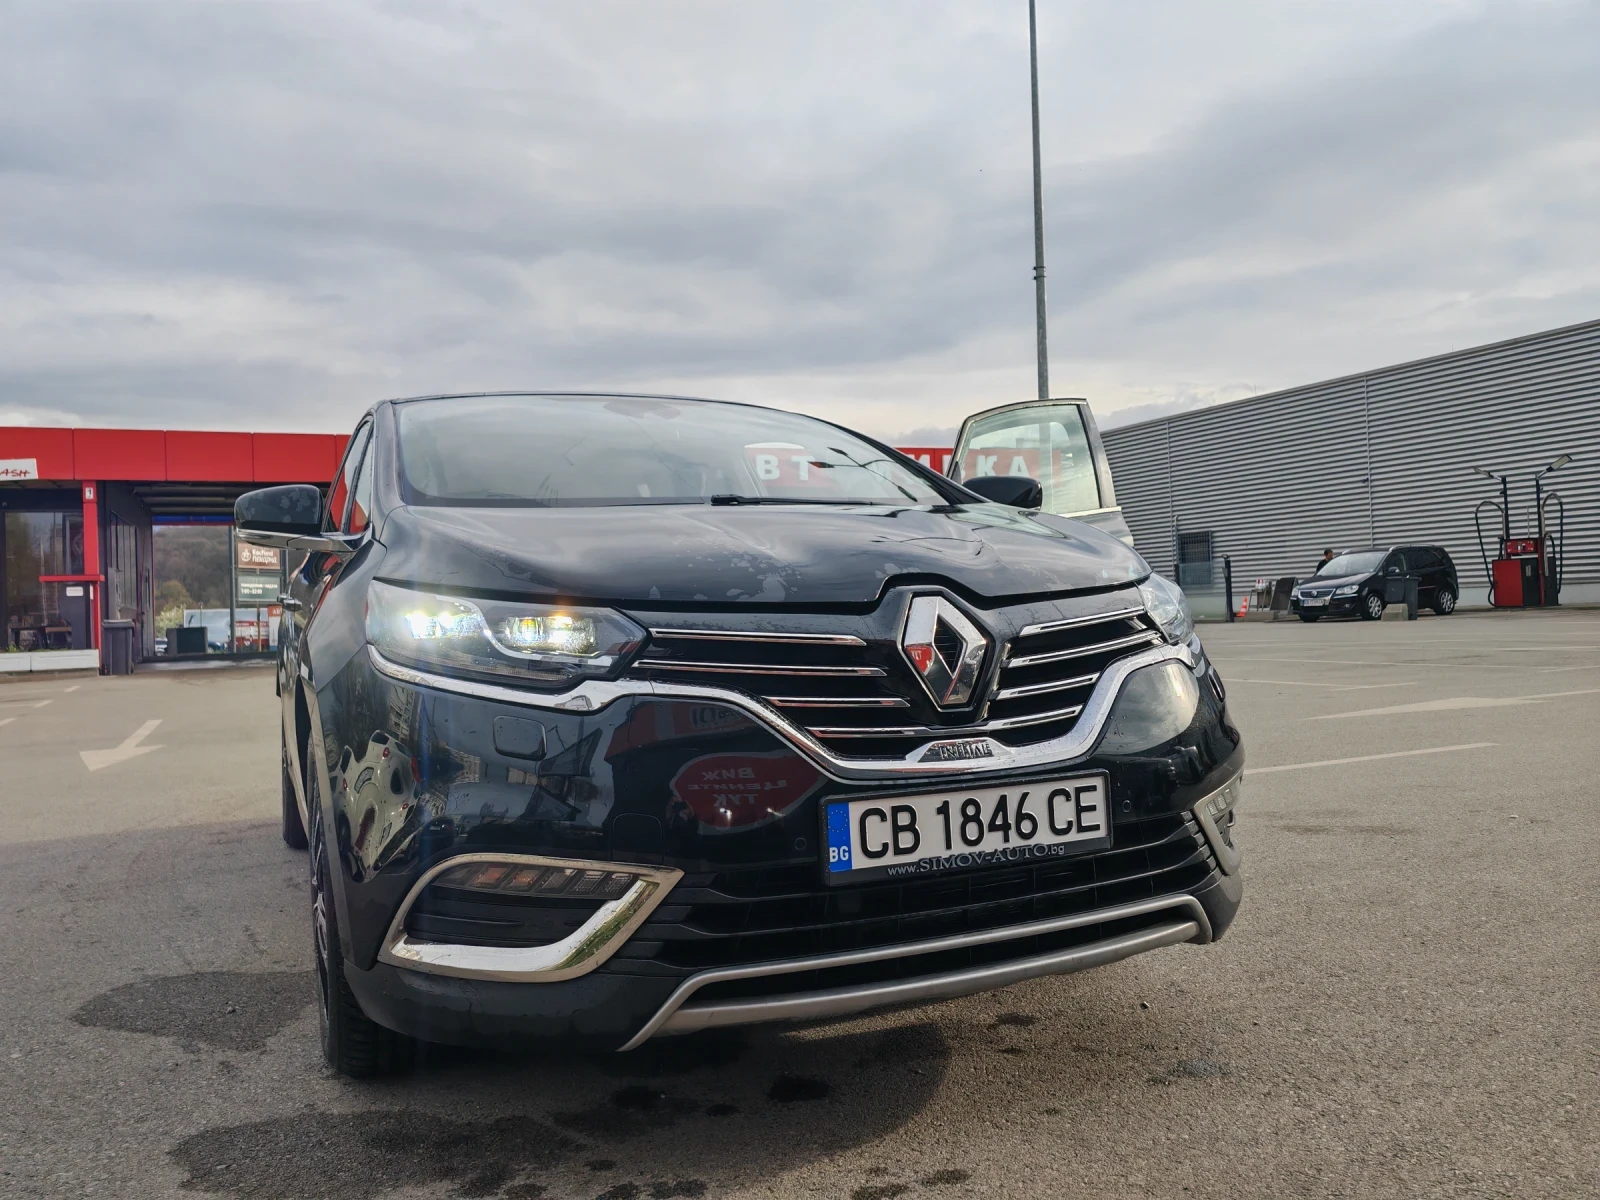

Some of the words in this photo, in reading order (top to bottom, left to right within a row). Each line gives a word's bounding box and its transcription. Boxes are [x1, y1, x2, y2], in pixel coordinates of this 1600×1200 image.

[858, 803, 922, 860] CB
[936, 791, 1040, 851] 1846
[1047, 784, 1102, 837] CE
[829, 845, 849, 863] BG
[887, 843, 1066, 877] www.SIMOV-AUTO.bg
